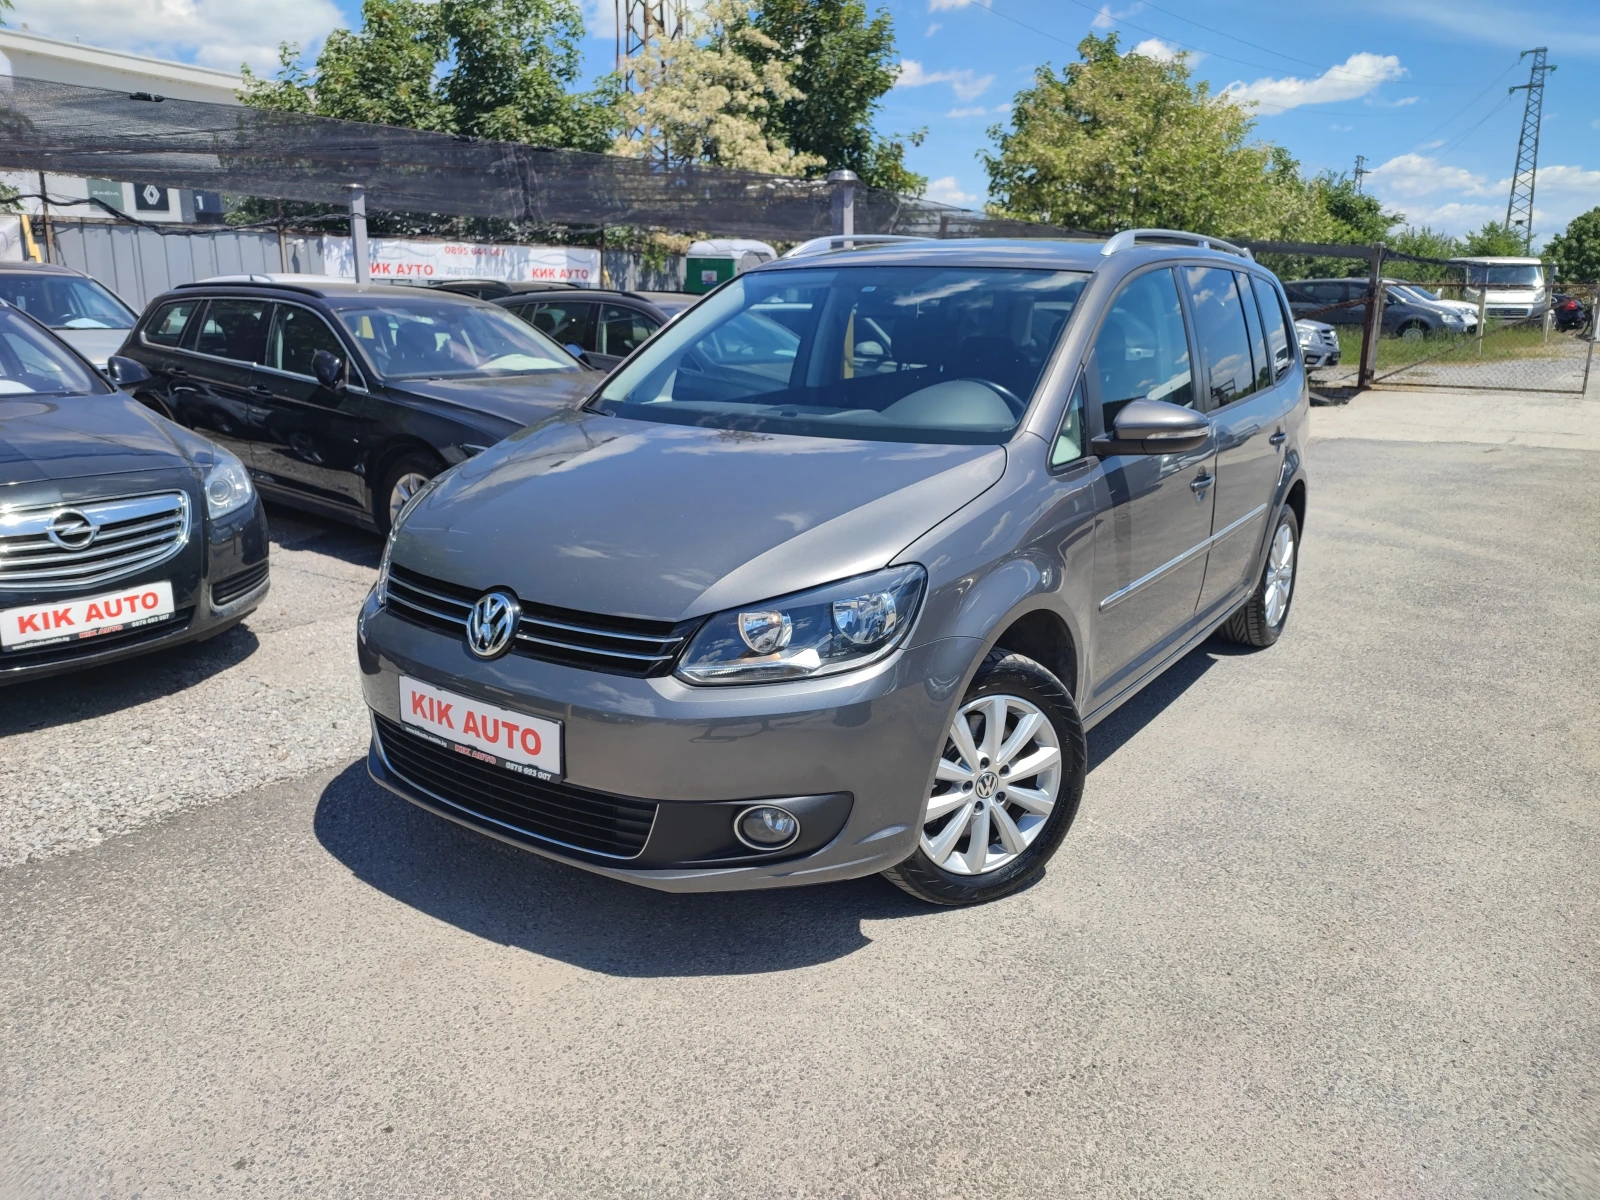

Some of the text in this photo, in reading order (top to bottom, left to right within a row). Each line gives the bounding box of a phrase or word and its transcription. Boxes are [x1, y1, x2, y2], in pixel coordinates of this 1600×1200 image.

[370, 263, 433, 276] ИК АУТО
[532, 268, 589, 279] КИК АУТО
[17, 591, 159, 635] KIK AUTO
[79, 624, 124, 638] KIK AUTO
[411, 690, 542, 756] KIK AUTO
[454, 744, 497, 764] KIK AUTO
[523, 767, 537, 777] 693
[538, 771, 552, 781] 007
